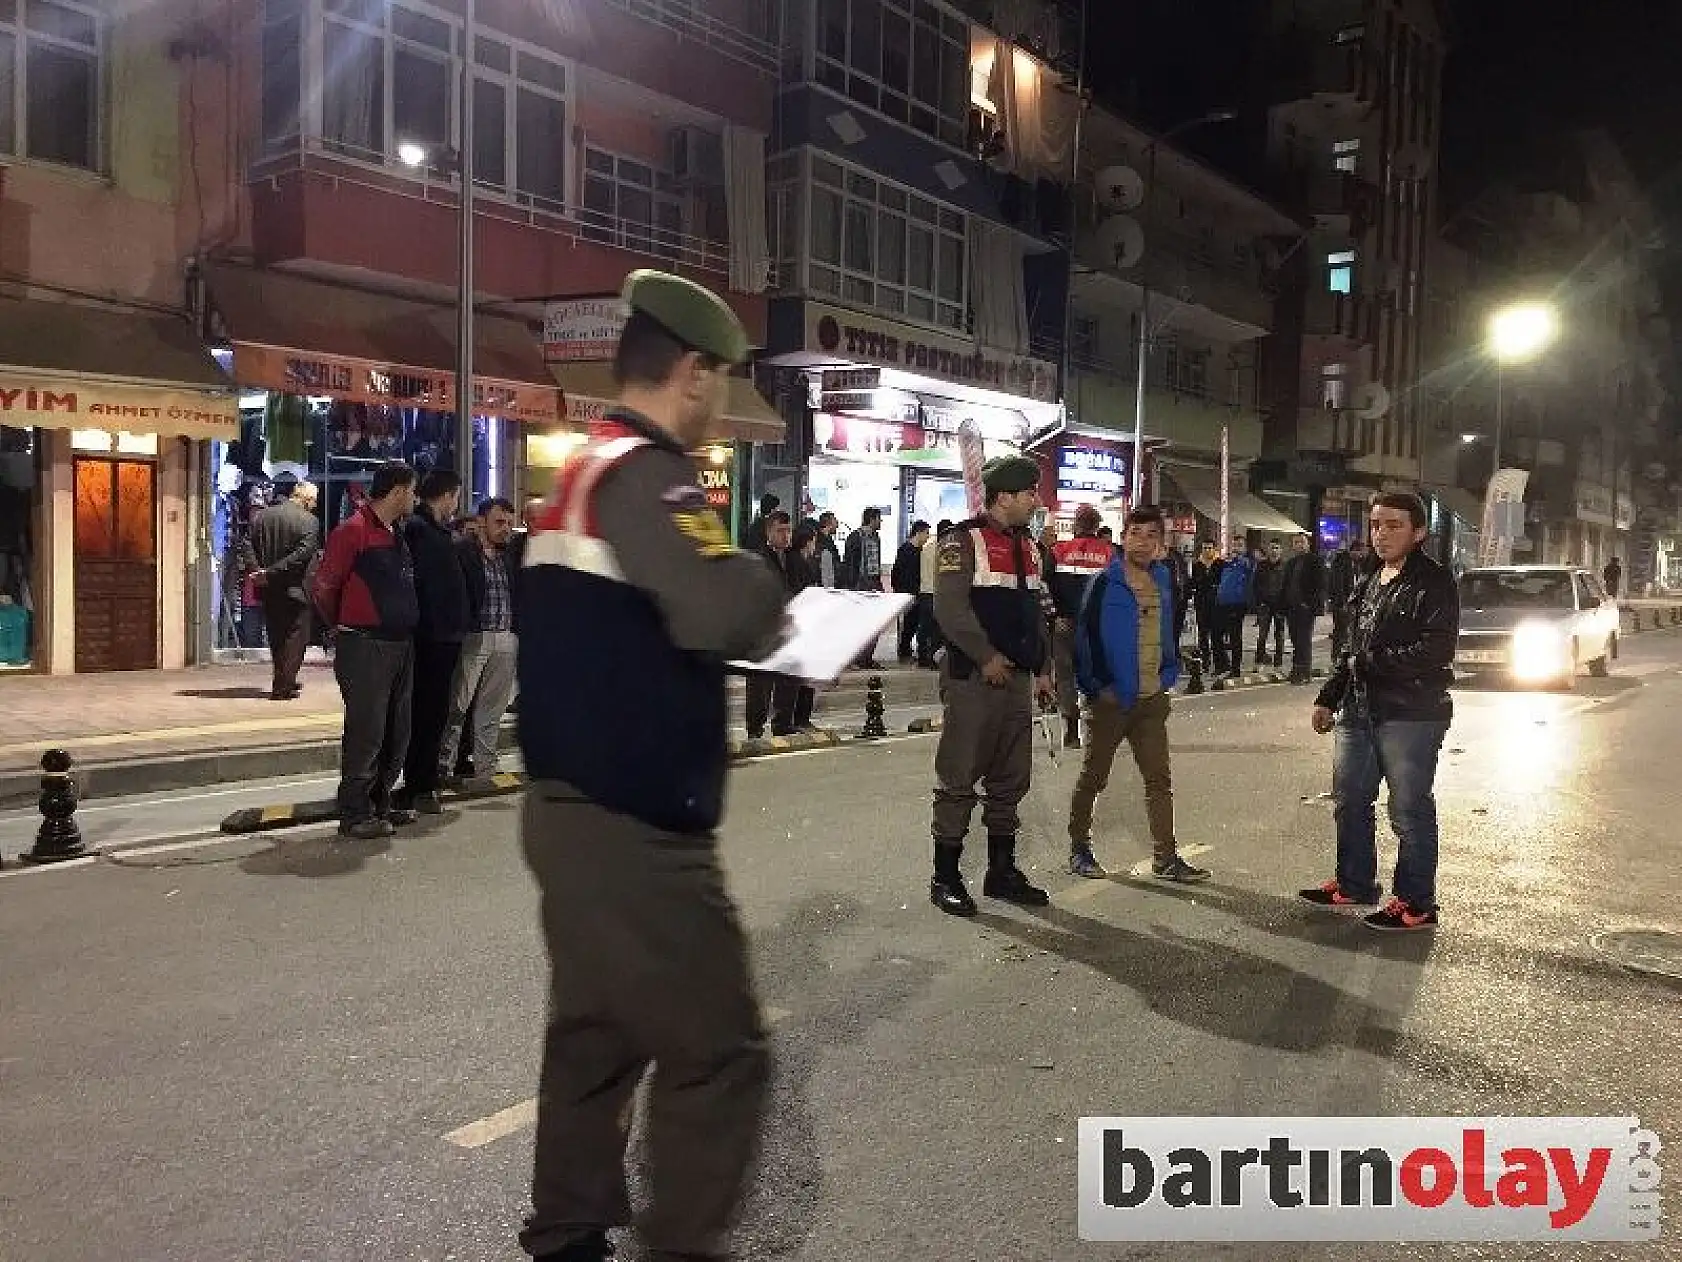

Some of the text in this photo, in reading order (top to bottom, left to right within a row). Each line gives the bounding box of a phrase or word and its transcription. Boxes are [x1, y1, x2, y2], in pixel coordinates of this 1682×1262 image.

[0, 386, 236, 425] YİM AHMET ÖZMEN
